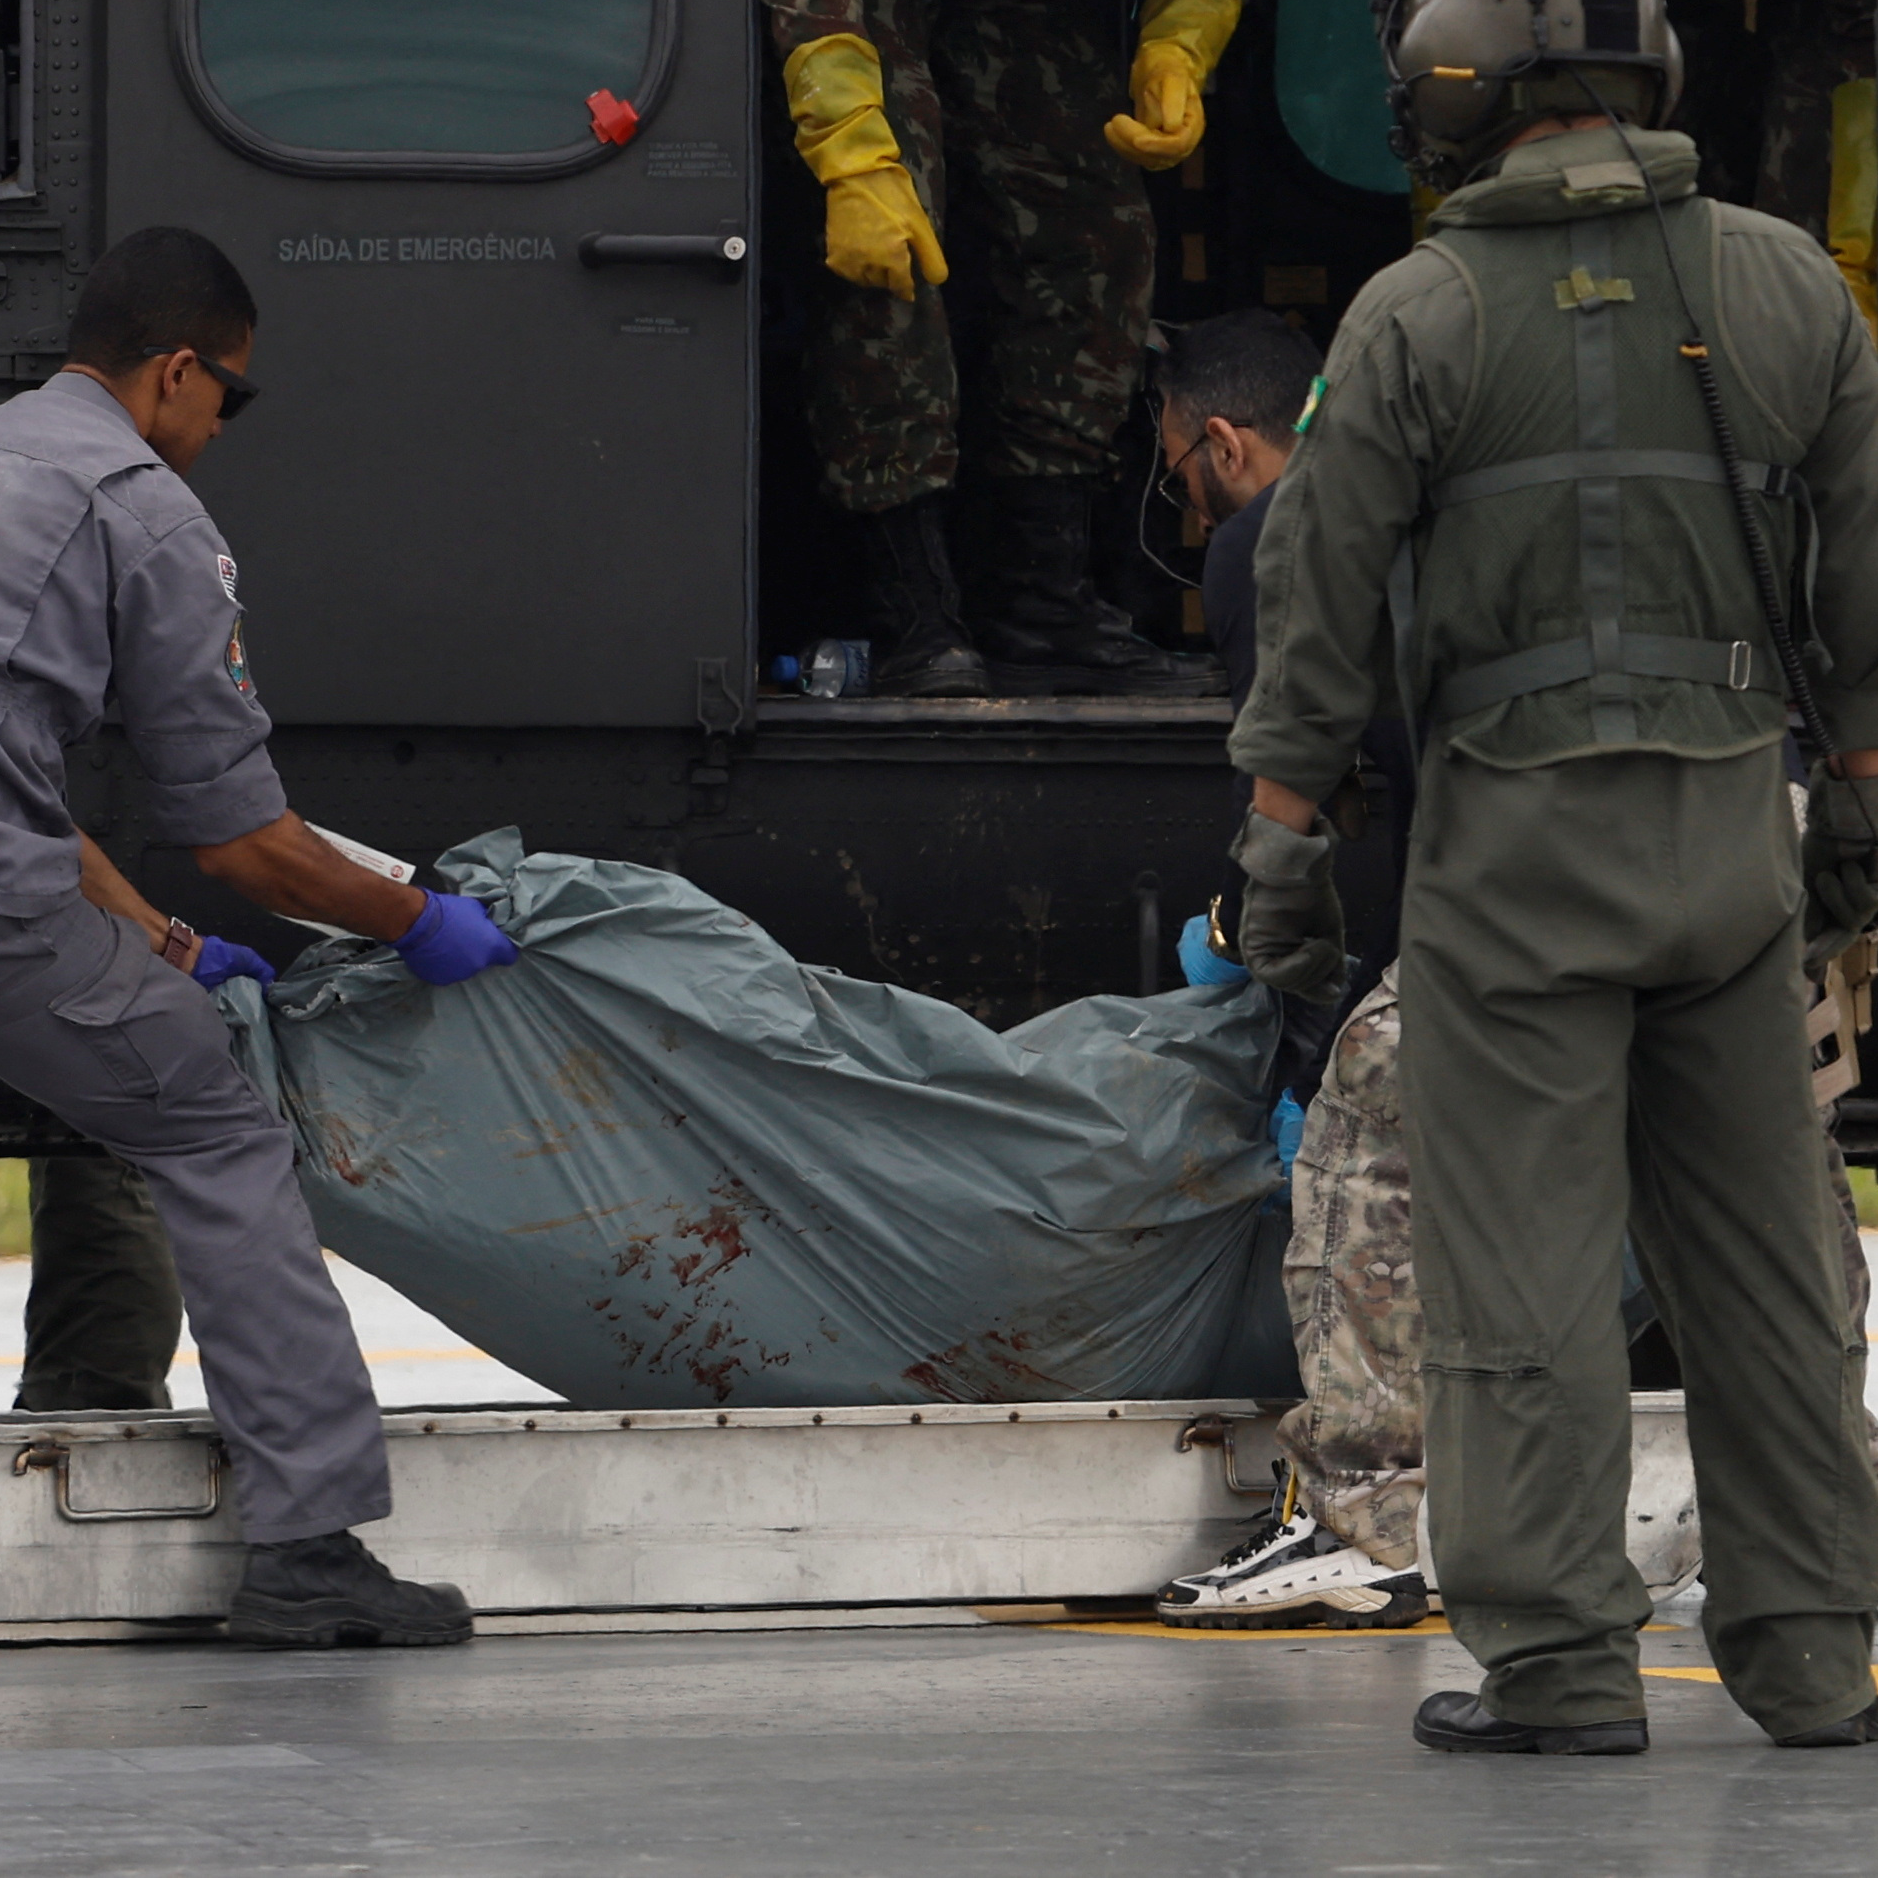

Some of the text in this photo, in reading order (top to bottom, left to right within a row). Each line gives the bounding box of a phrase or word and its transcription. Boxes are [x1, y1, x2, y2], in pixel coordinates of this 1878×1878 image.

[278, 232, 557, 262] SAÍDA DE EMERGÊNCIA
